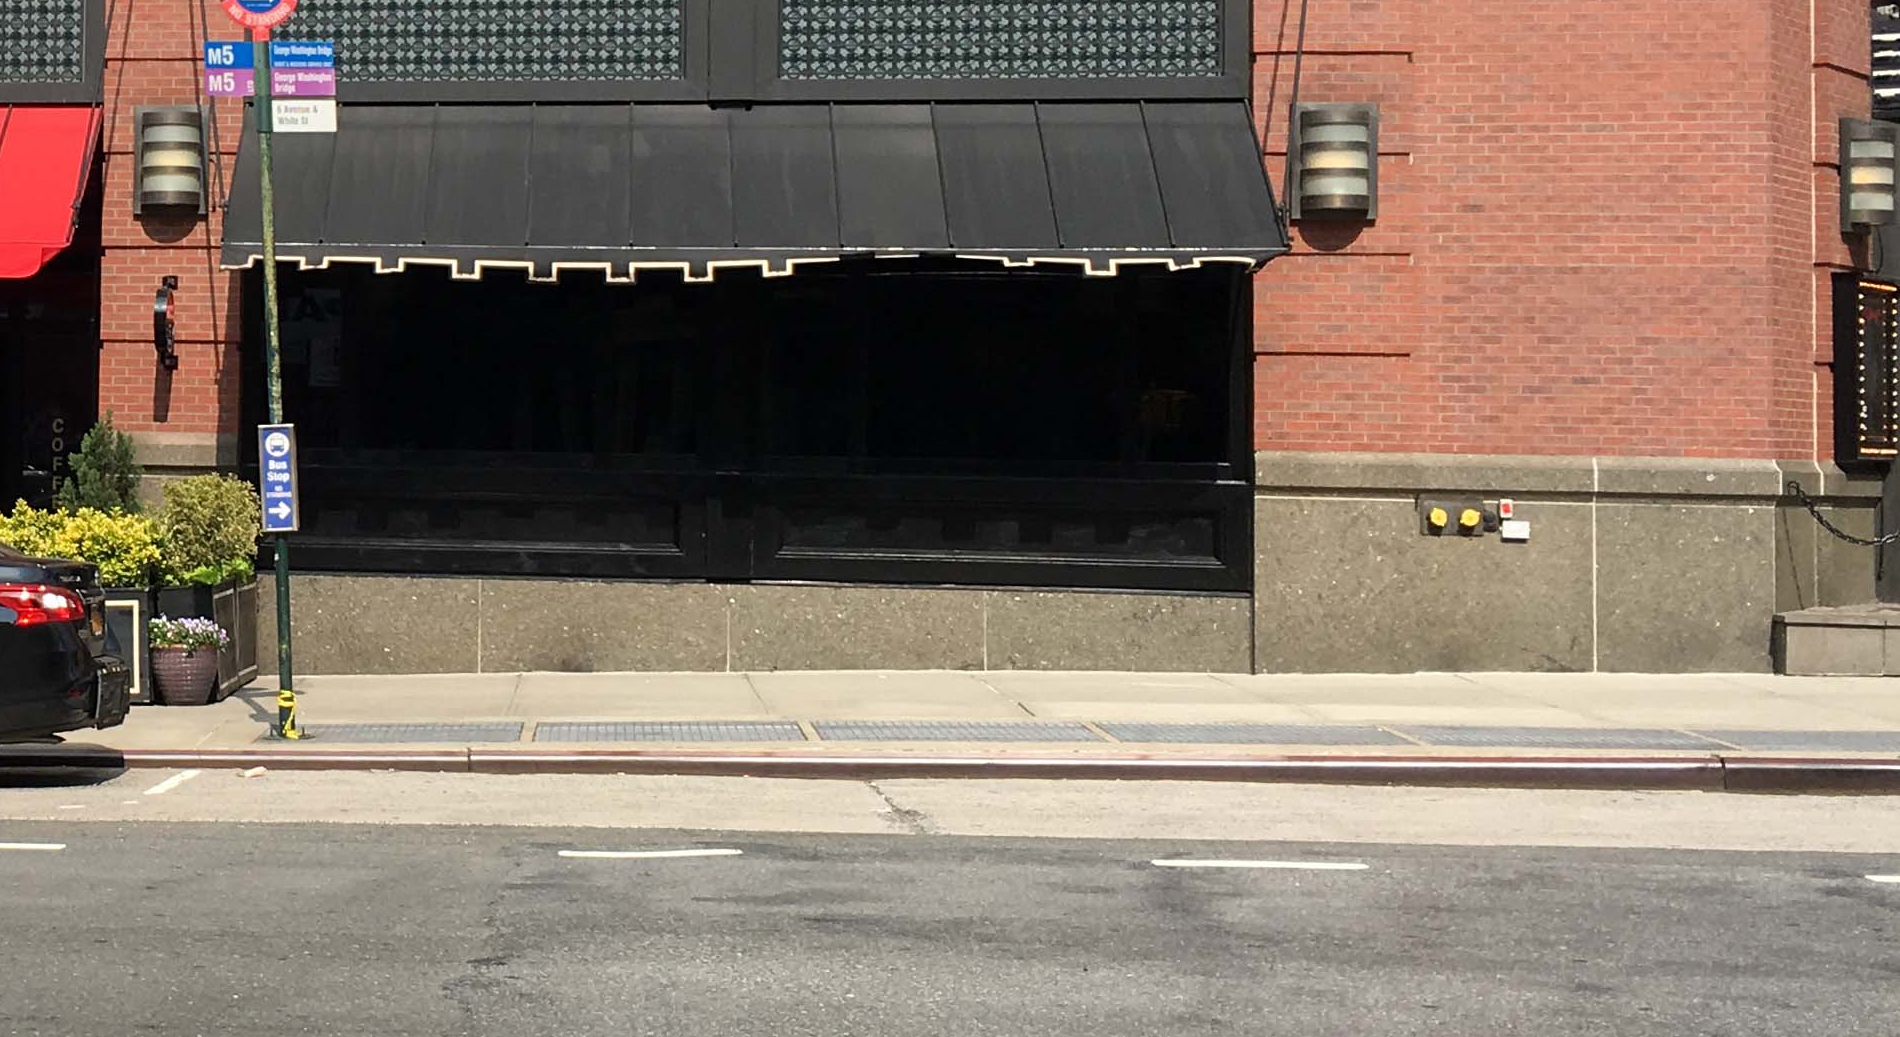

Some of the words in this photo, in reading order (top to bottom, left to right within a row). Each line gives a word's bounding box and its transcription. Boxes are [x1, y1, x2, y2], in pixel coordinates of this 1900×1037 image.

[227, 4, 243, 20] NO
[244, 3, 292, 26] STANDING
[207, 46, 234, 65] M5
[208, 73, 235, 93] M5
[274, 72, 296, 84] George
[297, 73, 333, 83] Washington
[274, 83, 296, 95] Bridge
[277, 116, 299, 125] White
[268, 459, 287, 470] Bus
[266, 471, 290, 484] Stop
